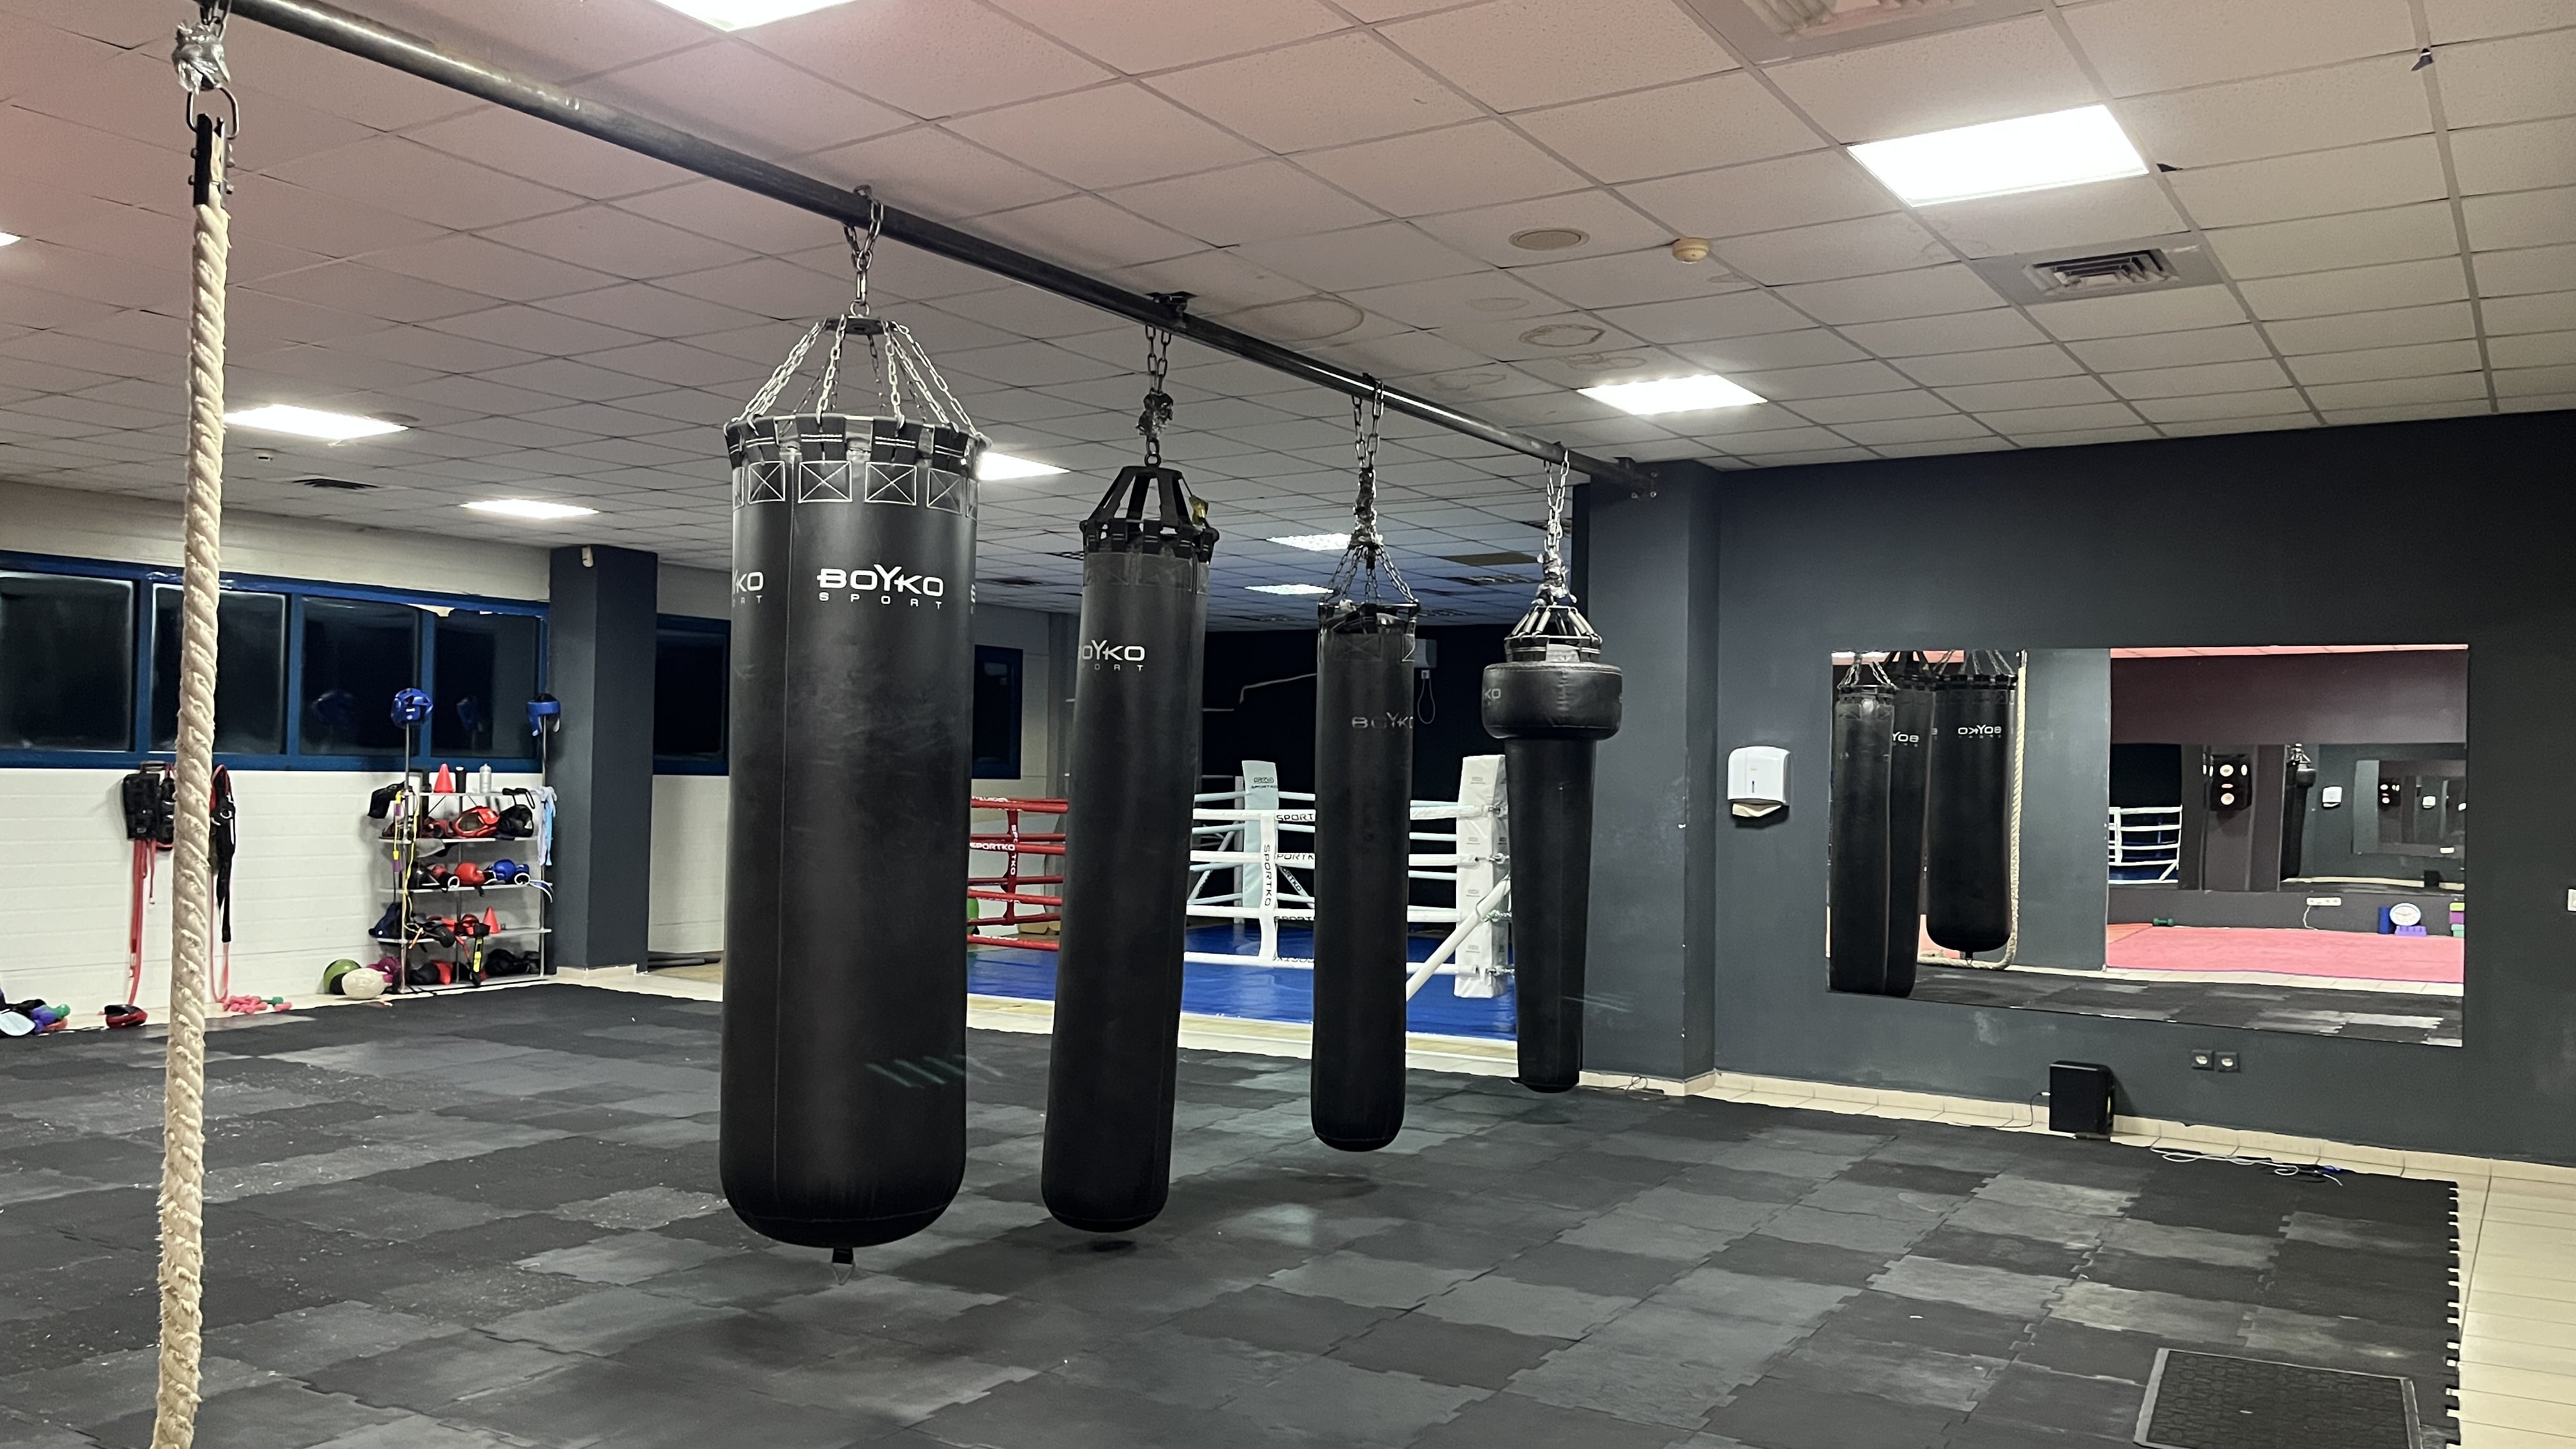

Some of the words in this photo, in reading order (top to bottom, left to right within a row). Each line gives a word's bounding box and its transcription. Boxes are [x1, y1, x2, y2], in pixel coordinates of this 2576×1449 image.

[816, 564, 944, 597] BOYKO
[819, 592, 942, 610] SPORT
[1264, 844, 1272, 906] SPORTKO
